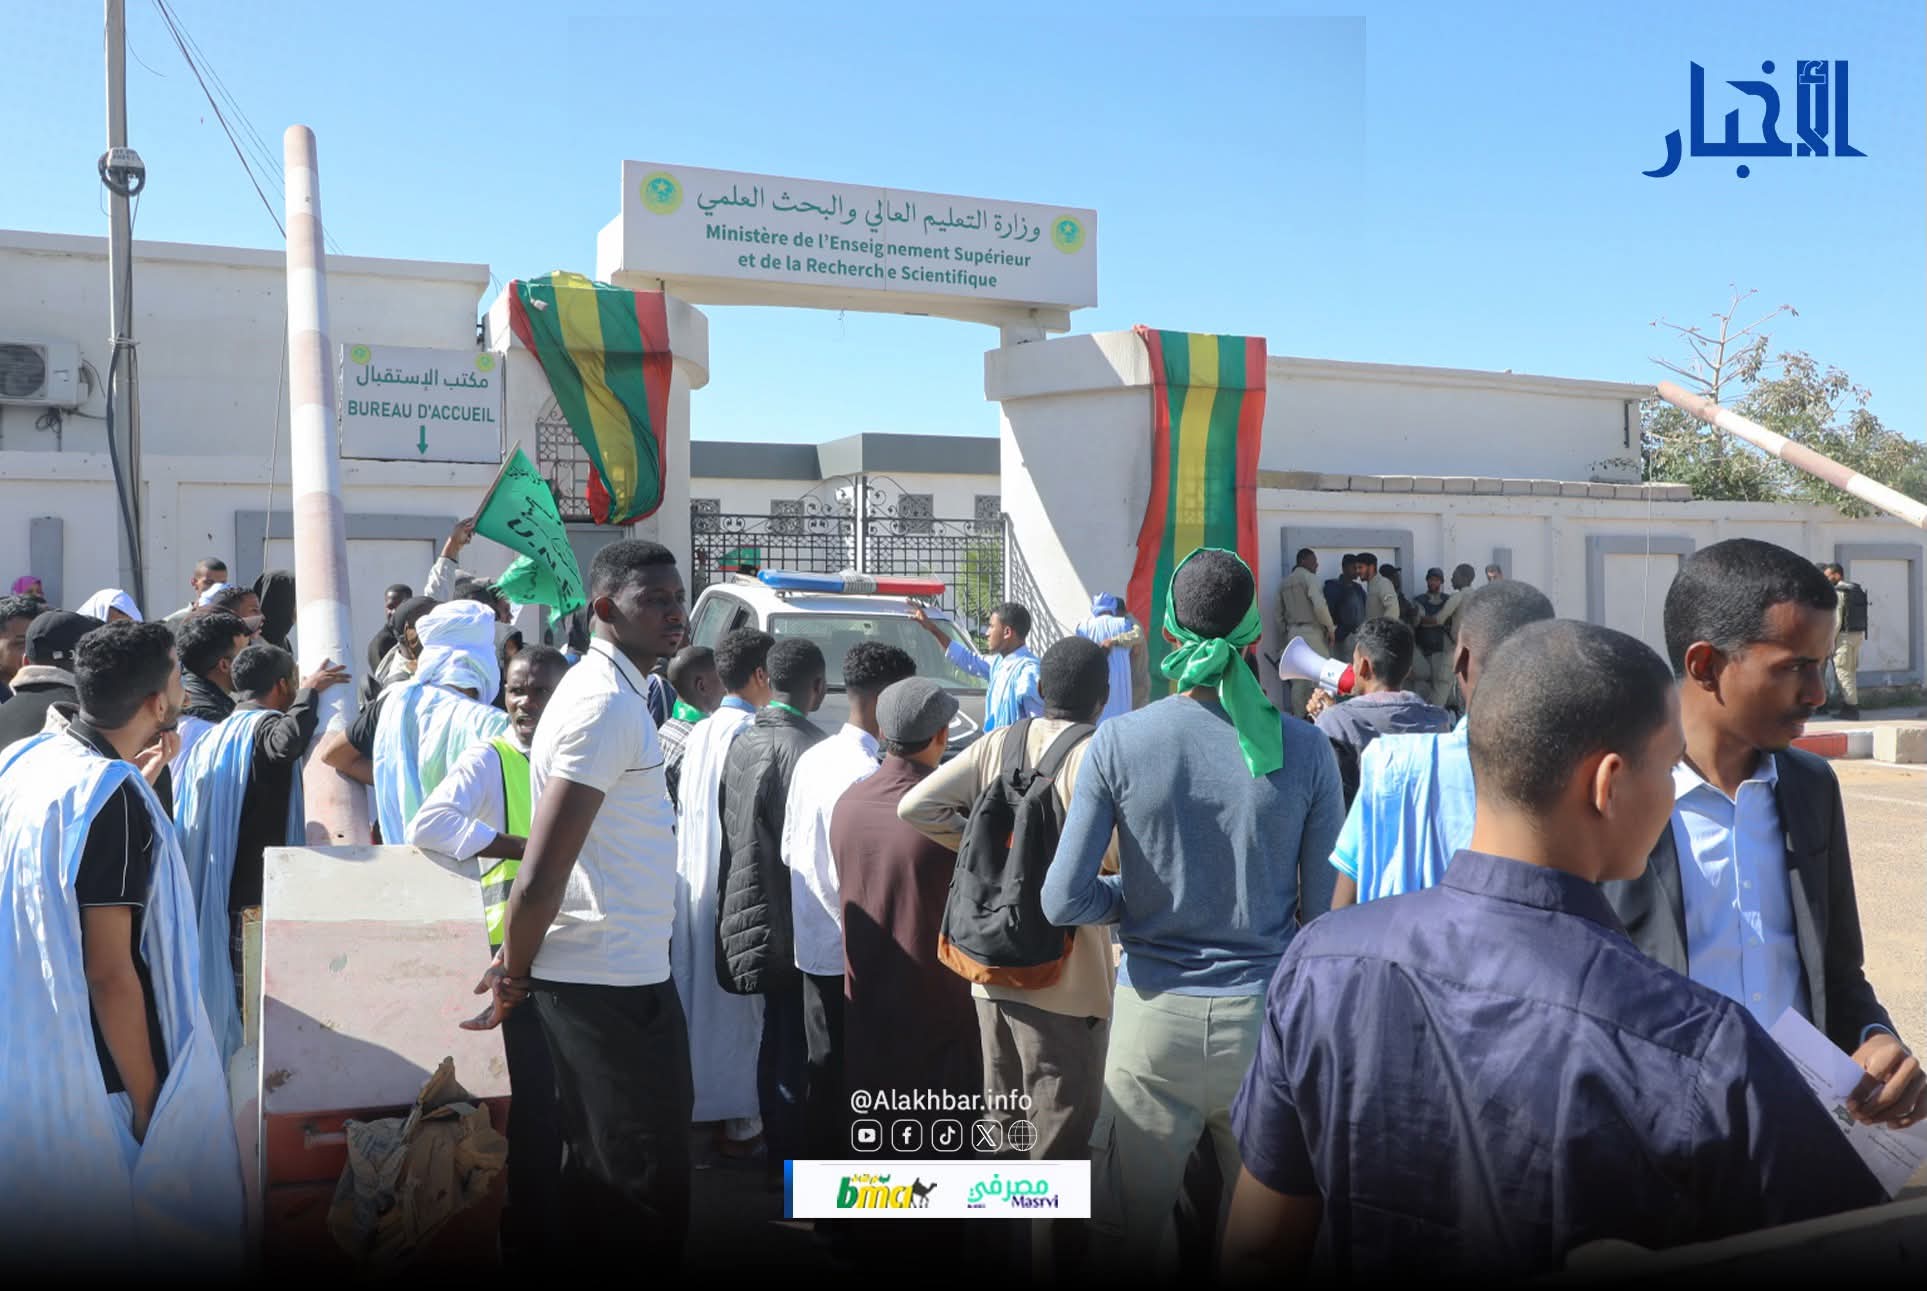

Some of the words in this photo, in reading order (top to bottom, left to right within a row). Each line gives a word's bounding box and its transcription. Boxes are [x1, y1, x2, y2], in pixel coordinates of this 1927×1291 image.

[697, 184, 764, 216] العلمي
[772, 192, 857, 225] والبحث
[865, 199, 916, 233] العالي
[923, 206, 987, 235] التعليم
[994, 213, 1041, 243] وزارة
[706, 223, 789, 246] Ministère
[793, 231, 814, 249] de
[954, 246, 1031, 267] Supérieur
[738, 253, 756, 268] et
[760, 253, 781, 270] de
[786, 255, 801, 271] la
[806, 257, 897, 279] Recherche
[901, 265, 998, 289] Scientifique
[356, 365, 438, 391] الإستقبال
[443, 371, 489, 391] مكتب
[348, 400, 412, 418] BUREAU
[418, 404, 495, 422] D'ACCUEIL
